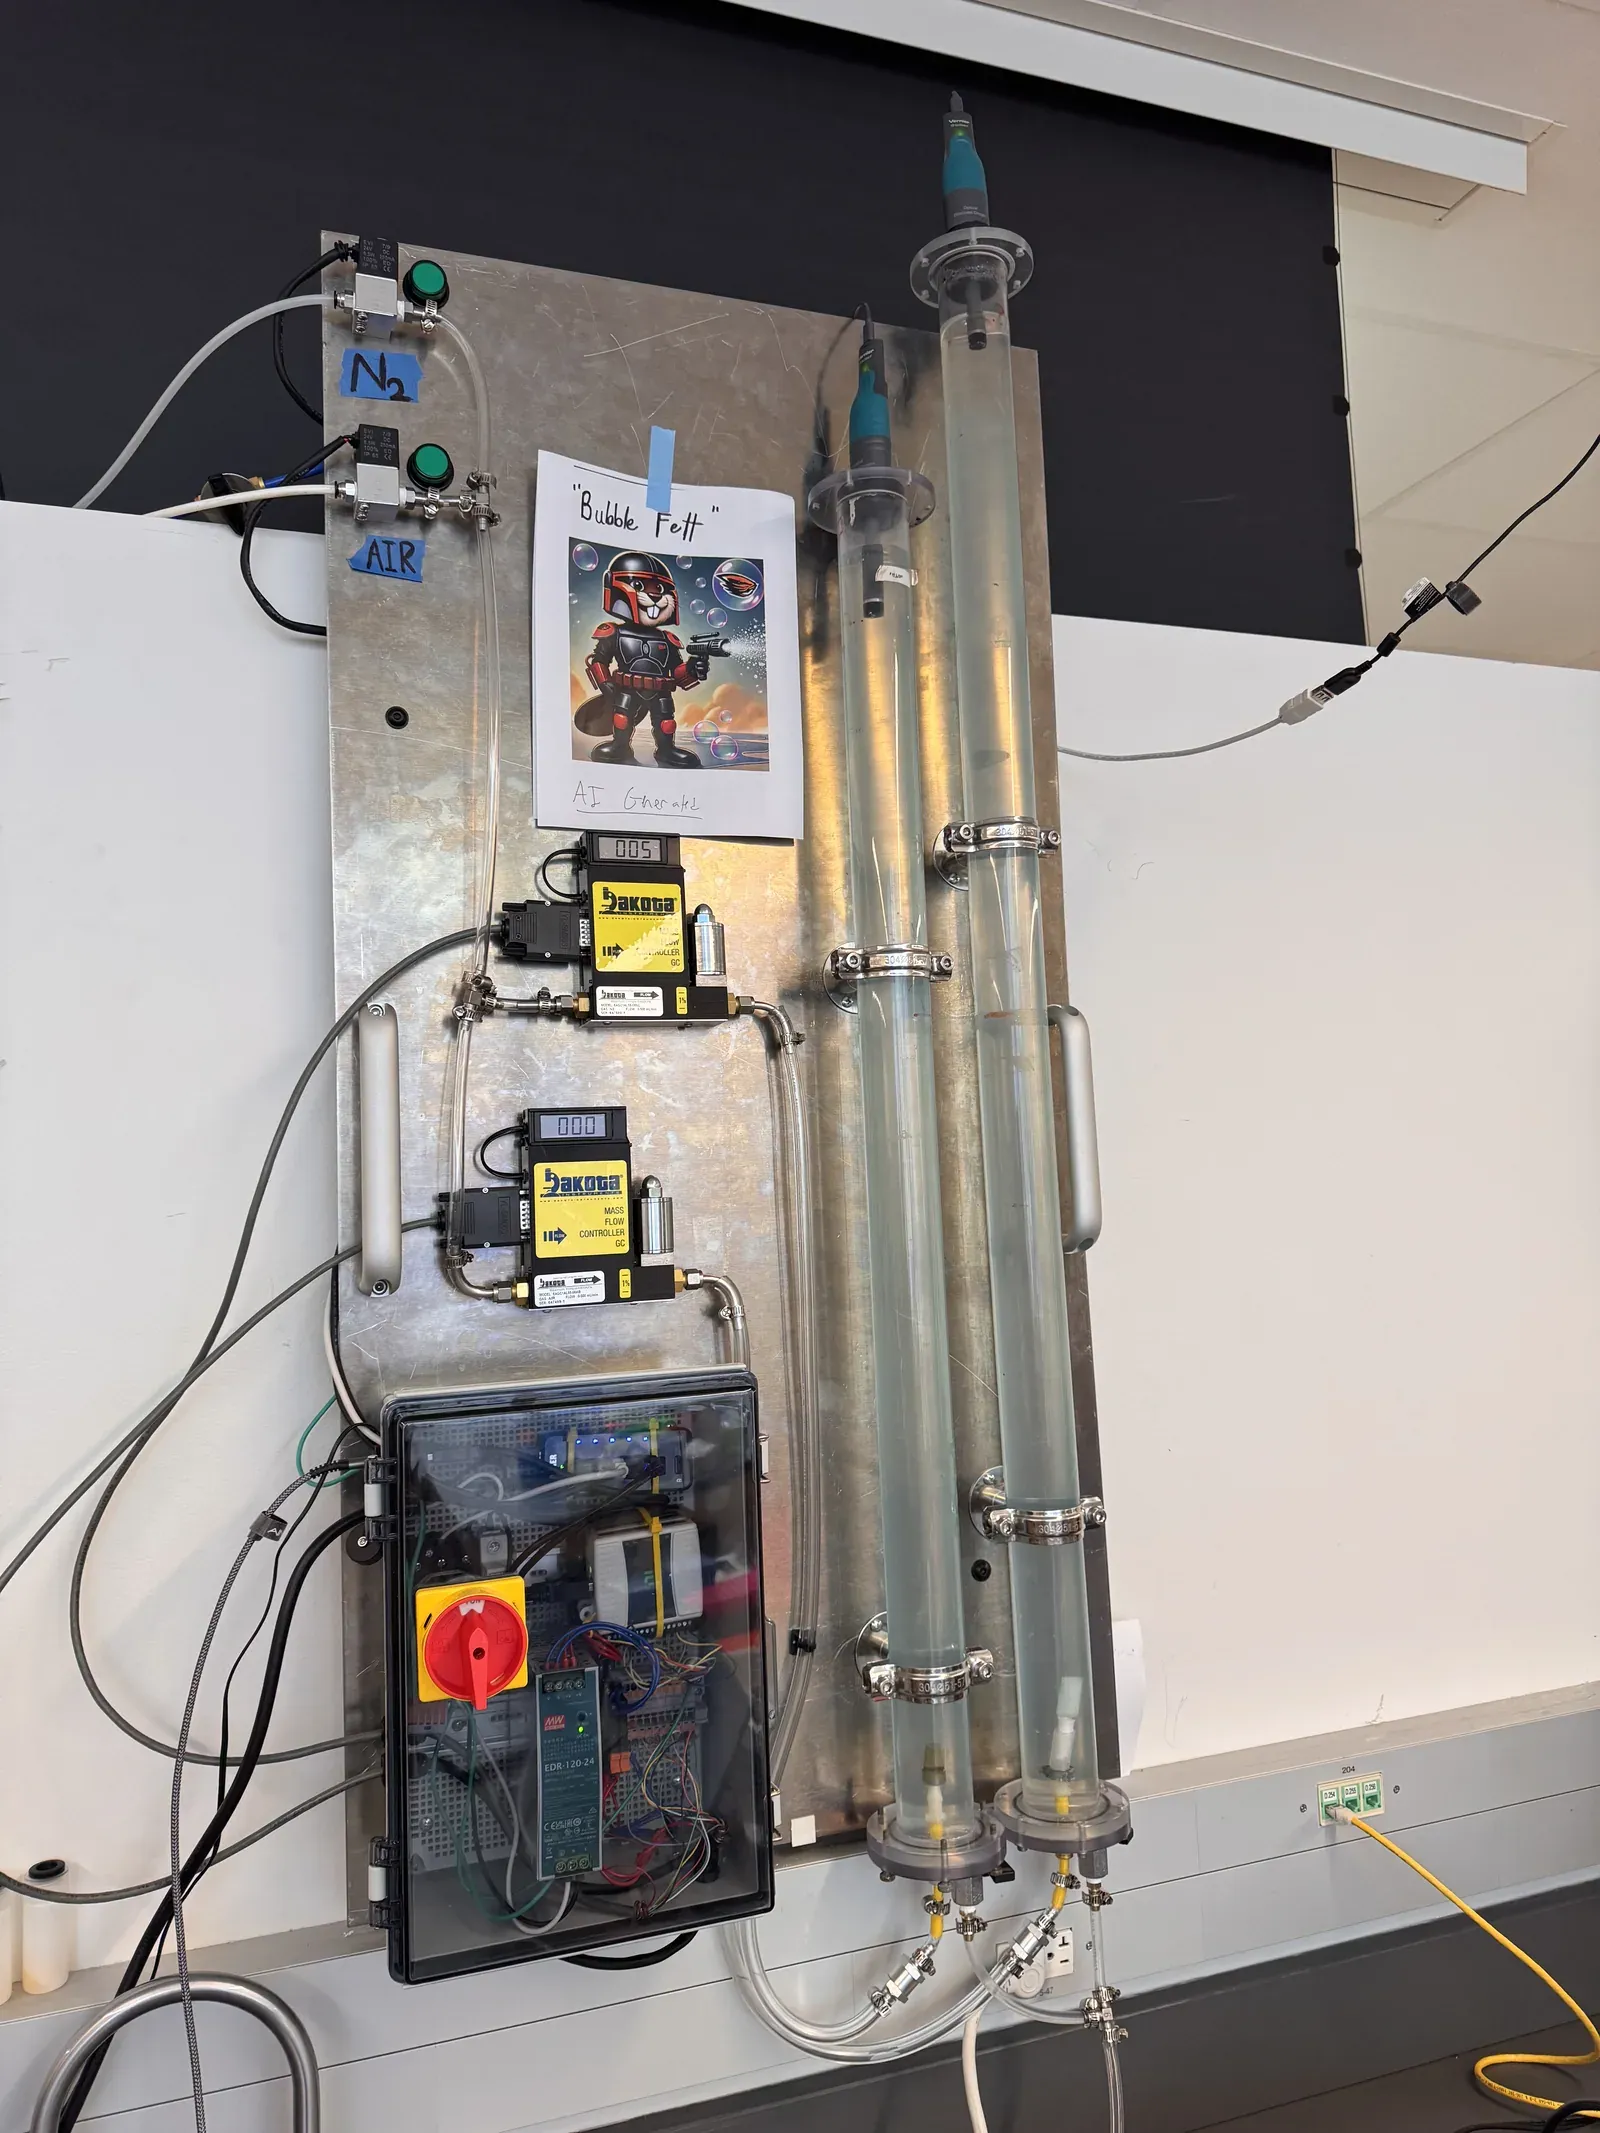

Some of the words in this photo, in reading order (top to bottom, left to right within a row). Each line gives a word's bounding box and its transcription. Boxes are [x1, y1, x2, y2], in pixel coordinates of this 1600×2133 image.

[366, 538, 417, 574] AIR
[573, 780, 605, 808] AI
[615, 839, 652, 859] 005
[670, 958, 681, 967] GC
[558, 1116, 596, 1136] 000
[604, 1206, 625, 1215] MASS
[604, 1217, 625, 1226] FLOW
[579, 1229, 625, 1238] CONTROLLER
[615, 1239, 626, 1248] GC
[544, 1714, 565, 1726] MW
[544, 1757, 595, 1772] EDR-120-24
[1341, 1765, 1356, 1774] 204
